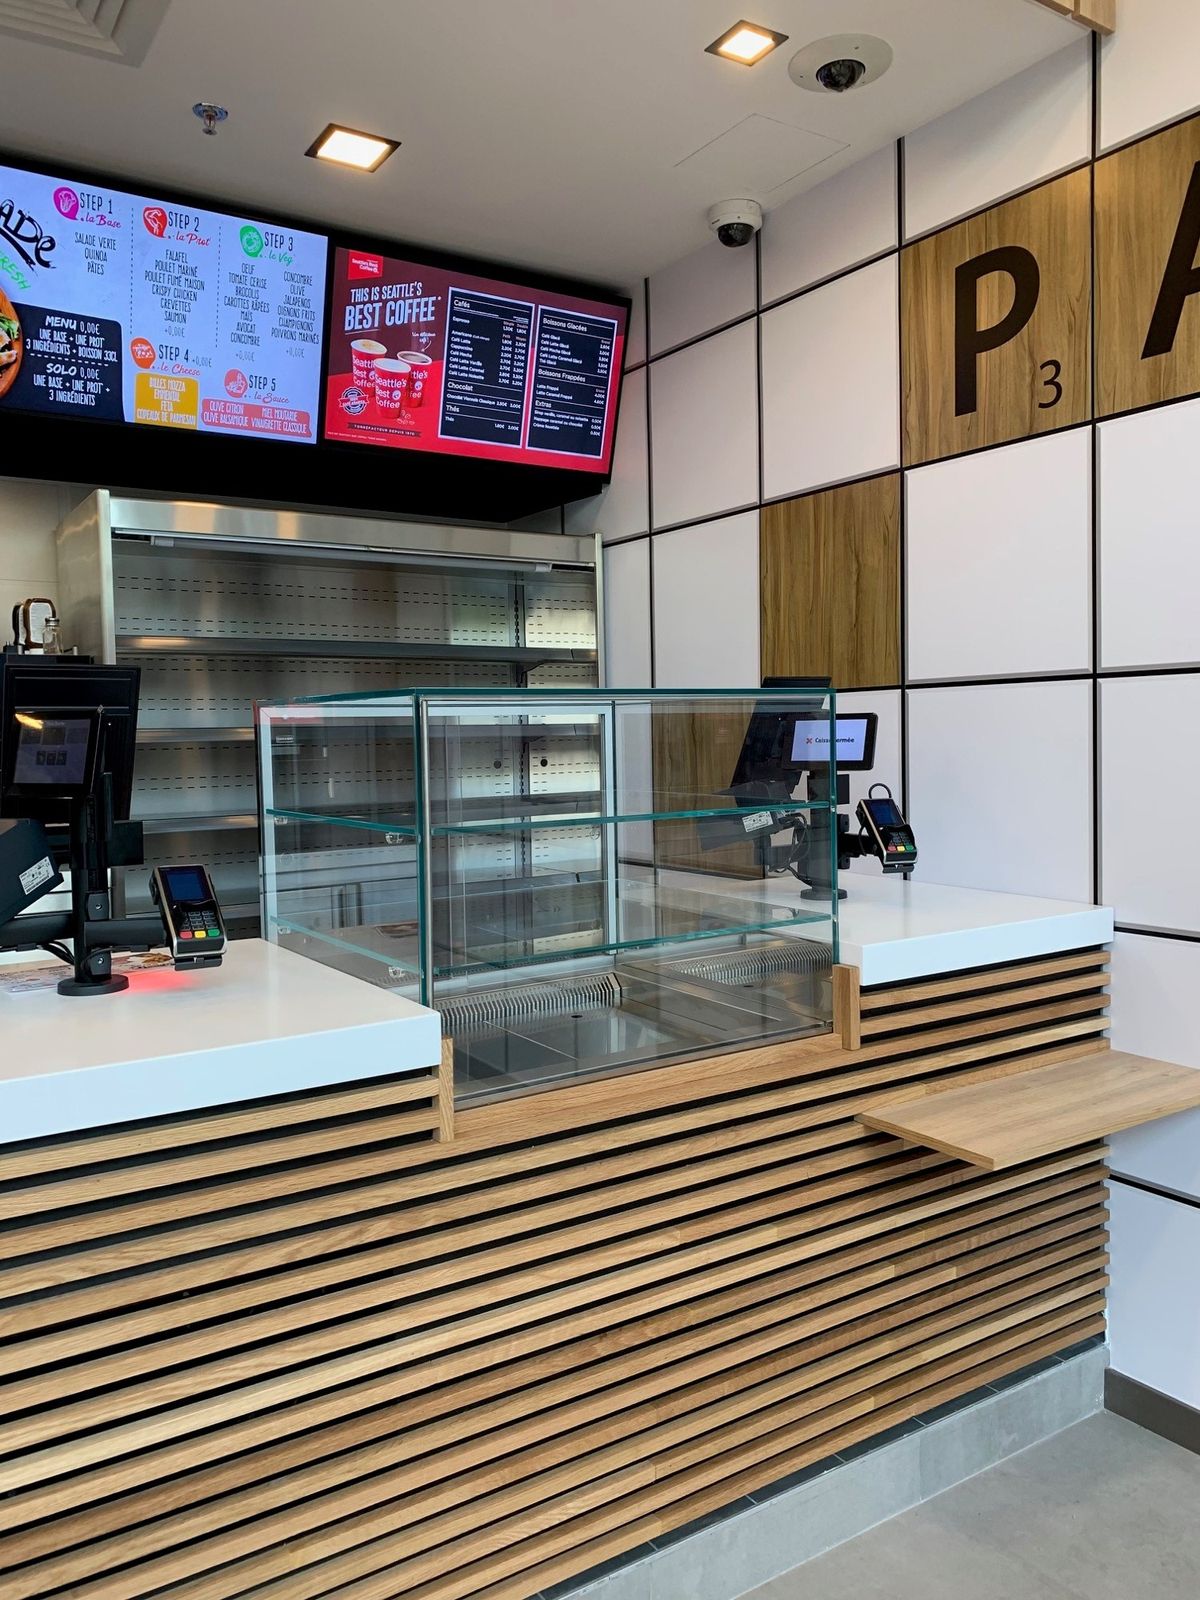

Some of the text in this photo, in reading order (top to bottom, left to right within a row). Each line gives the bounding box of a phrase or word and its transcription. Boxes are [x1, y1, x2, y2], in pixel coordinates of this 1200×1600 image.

[80, 192, 113, 214] STEP 1
[86, 213, 121, 228] la Base
[169, 211, 200, 232] STEP 2
[75, 232, 117, 252] SALADE VERTE
[176, 231, 184, 241] la
[265, 231, 294, 251] STEP 3
[85, 248, 108, 263] QUINOA
[166, 249, 188, 264] FALAFEL
[155, 260, 176, 273] POULET
[145, 269, 166, 284] POULET
[185, 277, 205, 291] MAISON
[229, 272, 267, 290] TOMATE CERISE
[284, 270, 313, 287] CONCOMBRE
[152, 284, 198, 302] CRISPY CHICKEN
[290, 284, 306, 297] OLIVE
[351, 281, 422, 303] THIS IS SEATTLE'S
[161, 297, 191, 313] CREVETTES
[224, 296, 250, 311] CAROTTES
[453, 299, 470, 309] Cafés
[45, 315, 77, 330] MENU
[164, 310, 187, 324] SAUMON
[345, 302, 382, 331] BEST
[543, 318, 566, 330] Boissons
[237, 321, 256, 335] AVOCAT
[279, 317, 314, 333] CHAMPIGNONS
[954, 245, 1063, 417] P 3
[39, 328, 52, 341] UNE
[53, 330, 68, 343] BASE
[75, 334, 88, 347] UNE
[231, 332, 261, 347] CONCOMBRE
[272, 326, 297, 342] POIVRONS
[26, 339, 31, 350] 3
[78, 346, 102, 360] BOISSON
[158, 344, 189, 363] STEP 4
[46, 363, 77, 376] SOLO
[171, 363, 202, 377] Cheese
[538, 368, 561, 380] Boissons
[33, 373, 47, 387] UNE
[48, 376, 63, 389] BASE
[72, 379, 85, 392] UNE
[248, 375, 276, 392] STEP 5
[49, 389, 54, 401] 3
